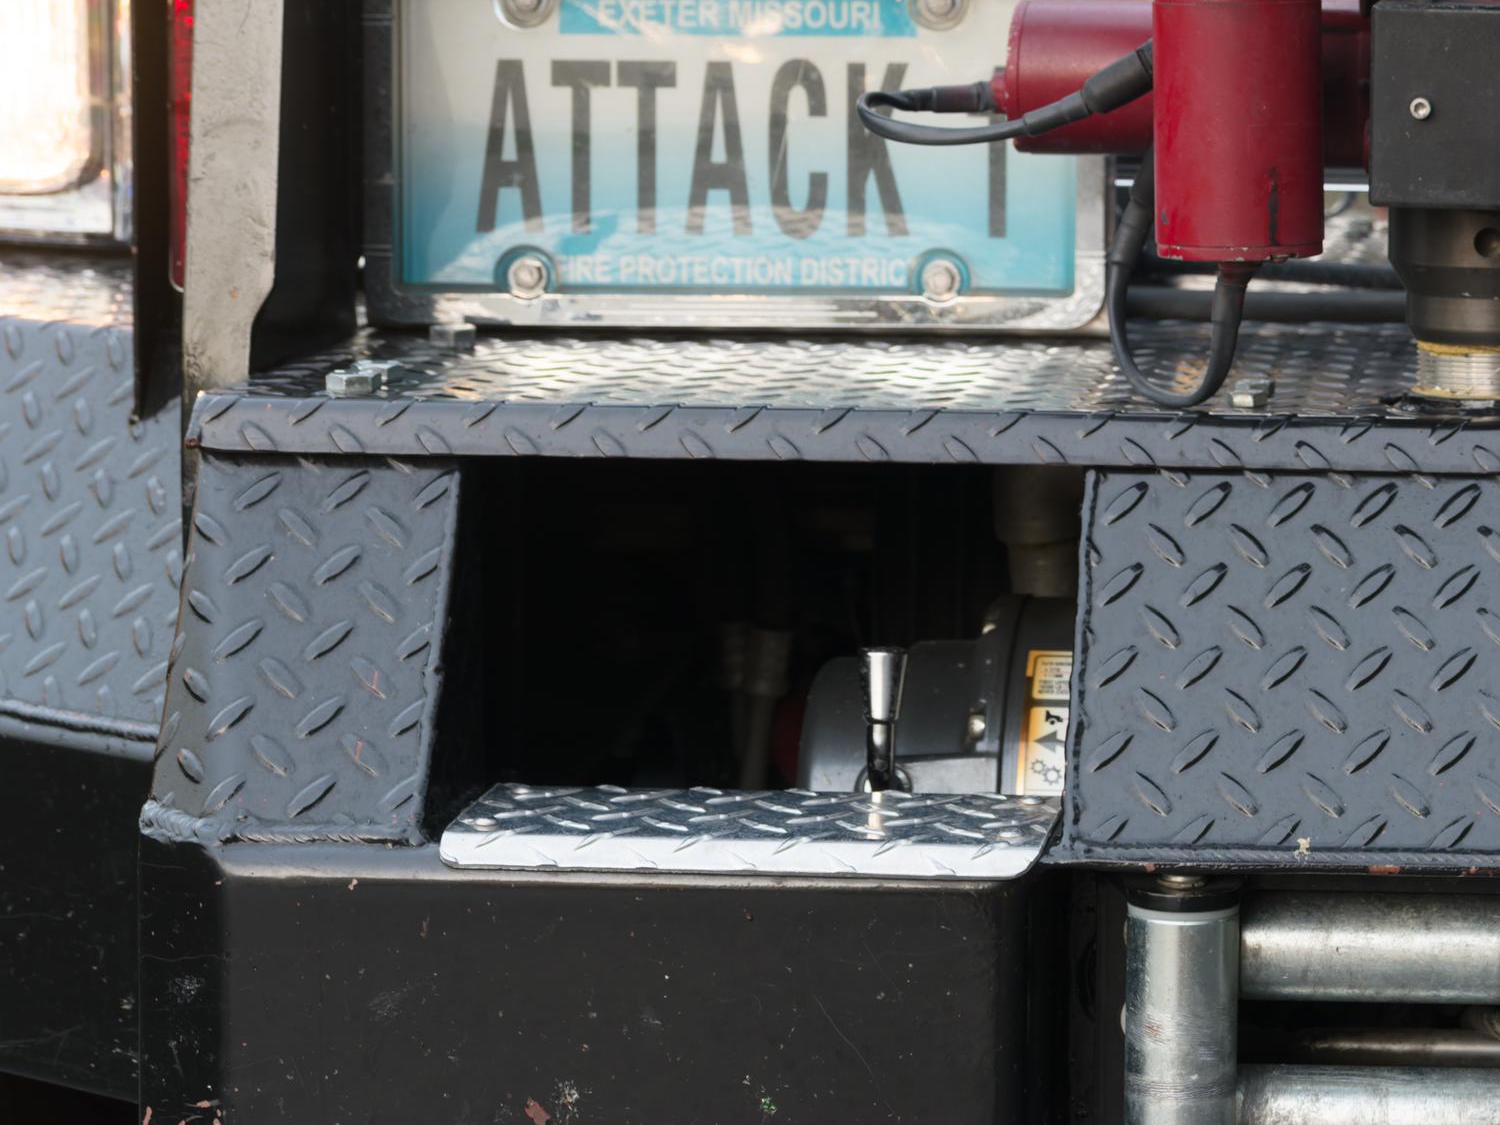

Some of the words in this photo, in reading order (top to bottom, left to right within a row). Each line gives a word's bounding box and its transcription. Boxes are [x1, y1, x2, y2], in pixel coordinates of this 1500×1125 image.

[728, 0, 881, 30] MISSOURI
[475, 59, 910, 239] ATTACK
[619, 256, 791, 285] PROTECTION
[800, 258, 911, 286] DISTRIC
